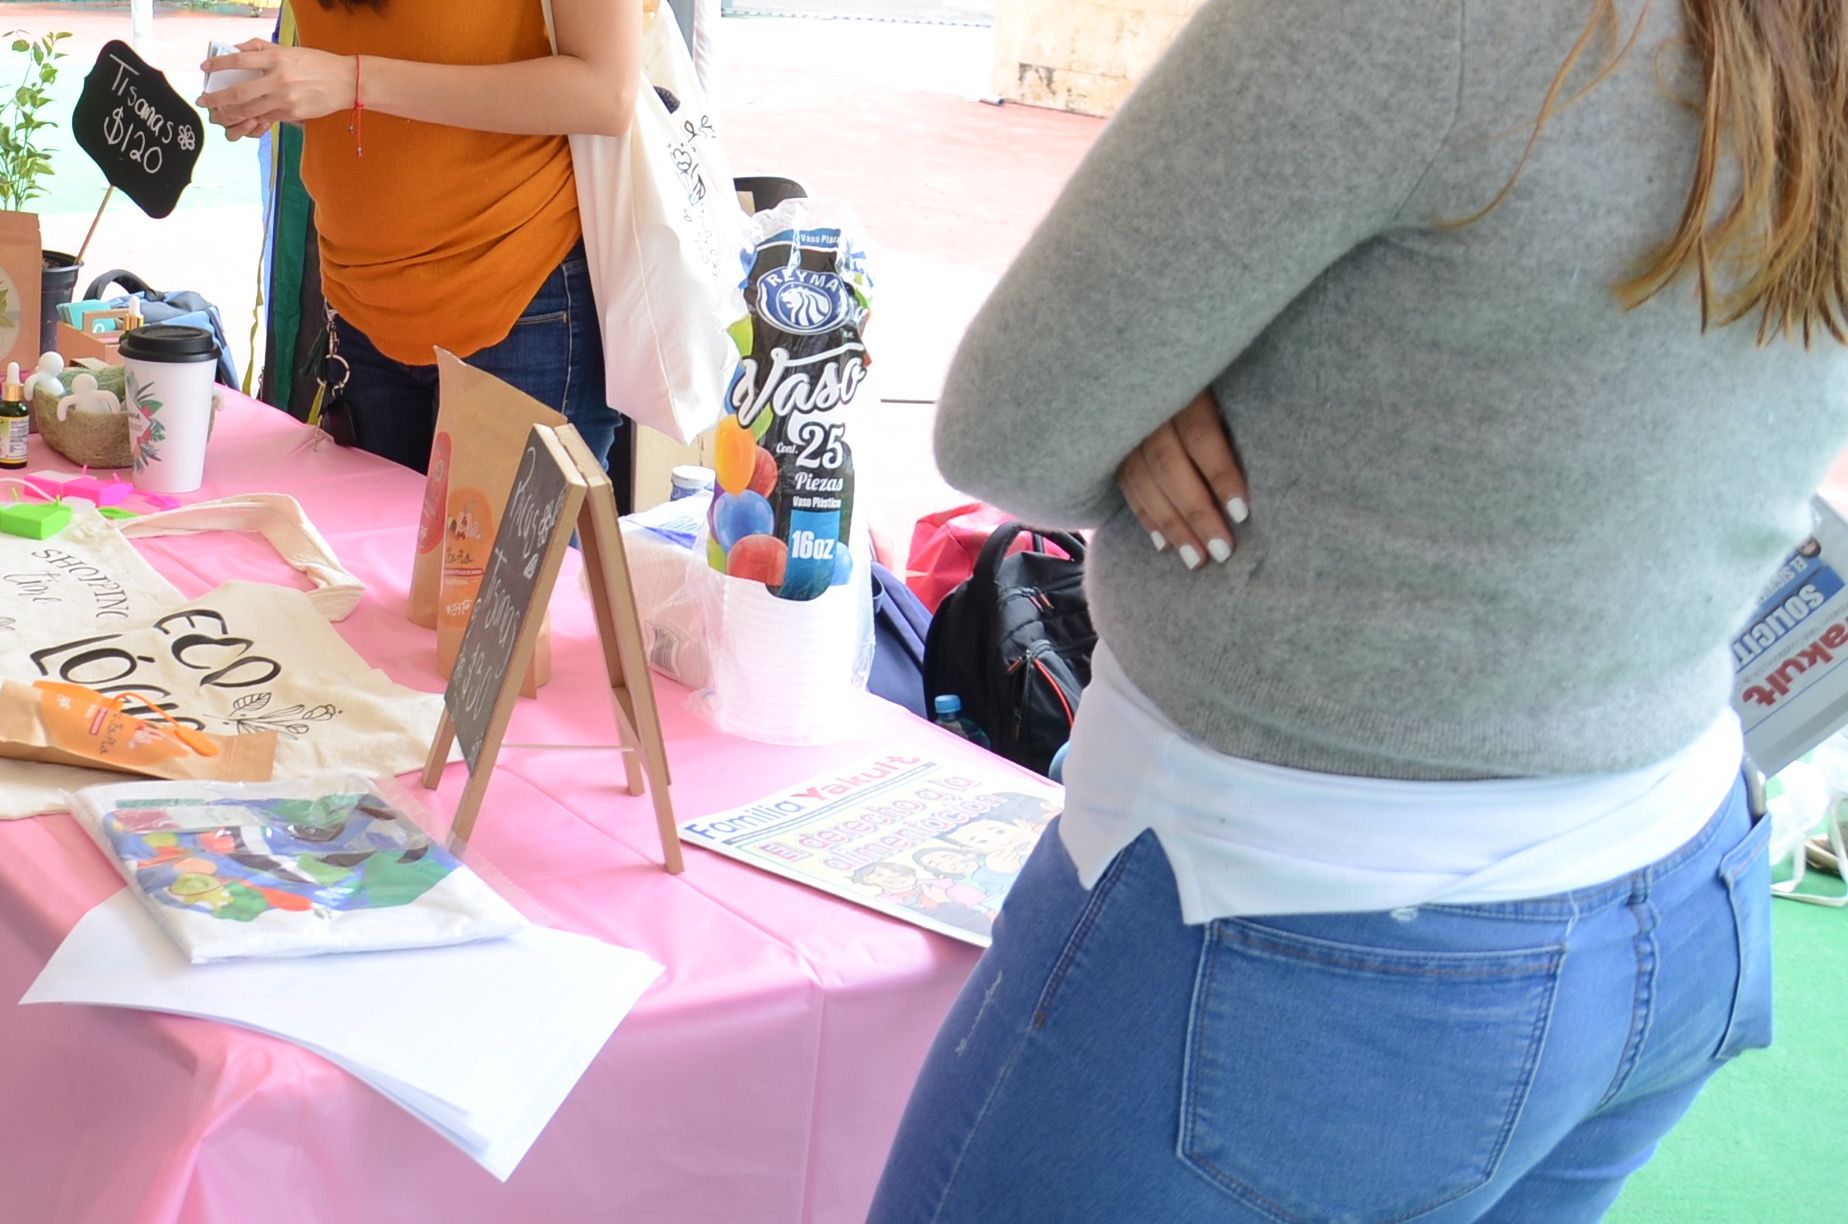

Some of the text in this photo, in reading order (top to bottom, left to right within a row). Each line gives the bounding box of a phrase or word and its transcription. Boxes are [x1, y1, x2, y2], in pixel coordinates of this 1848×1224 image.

[109, 53, 174, 144] Tisanas
[103, 106, 163, 174] $120
[766, 269, 841, 293] REYMA
[732, 343, 867, 427] Vaso
[794, 472, 844, 492] Piezas
[795, 422, 846, 469] 25
[793, 496, 812, 507] Vaso
[791, 530, 836, 560] 16oz
[153, 609, 282, 688] ECO
[1742, 616, 1848, 707] akult
[684, 755, 921, 840] Familia Yakult
[759, 842, 808, 862] El
[797, 798, 924, 850] derecho
[927, 776, 979, 793] la
[821, 791, 1009, 873] alimentación
